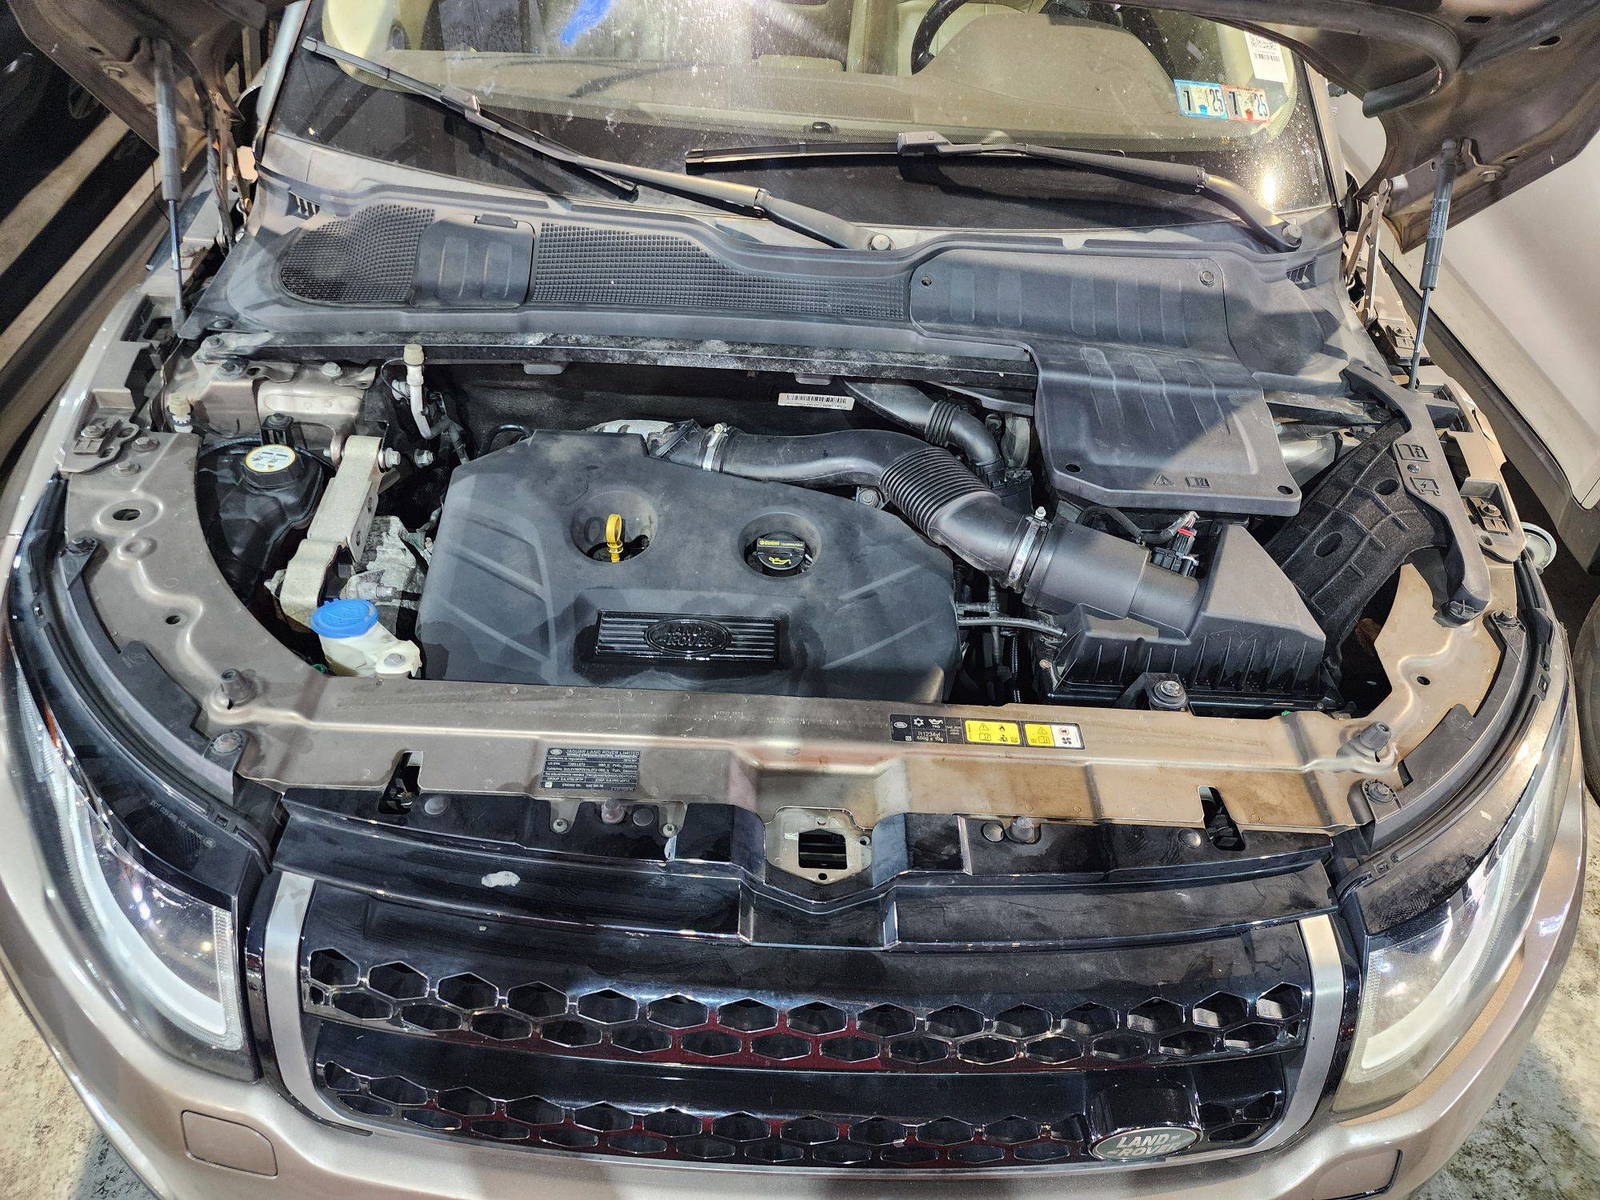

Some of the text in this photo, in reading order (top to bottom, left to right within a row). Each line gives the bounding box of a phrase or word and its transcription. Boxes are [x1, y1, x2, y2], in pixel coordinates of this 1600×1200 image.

[1183, 88, 1223, 112] 7 25
[1228, 91, 1268, 117] 7 25
[1116, 1133, 1170, 1148] LAND
[1117, 1142, 1180, 1156] ROVER
